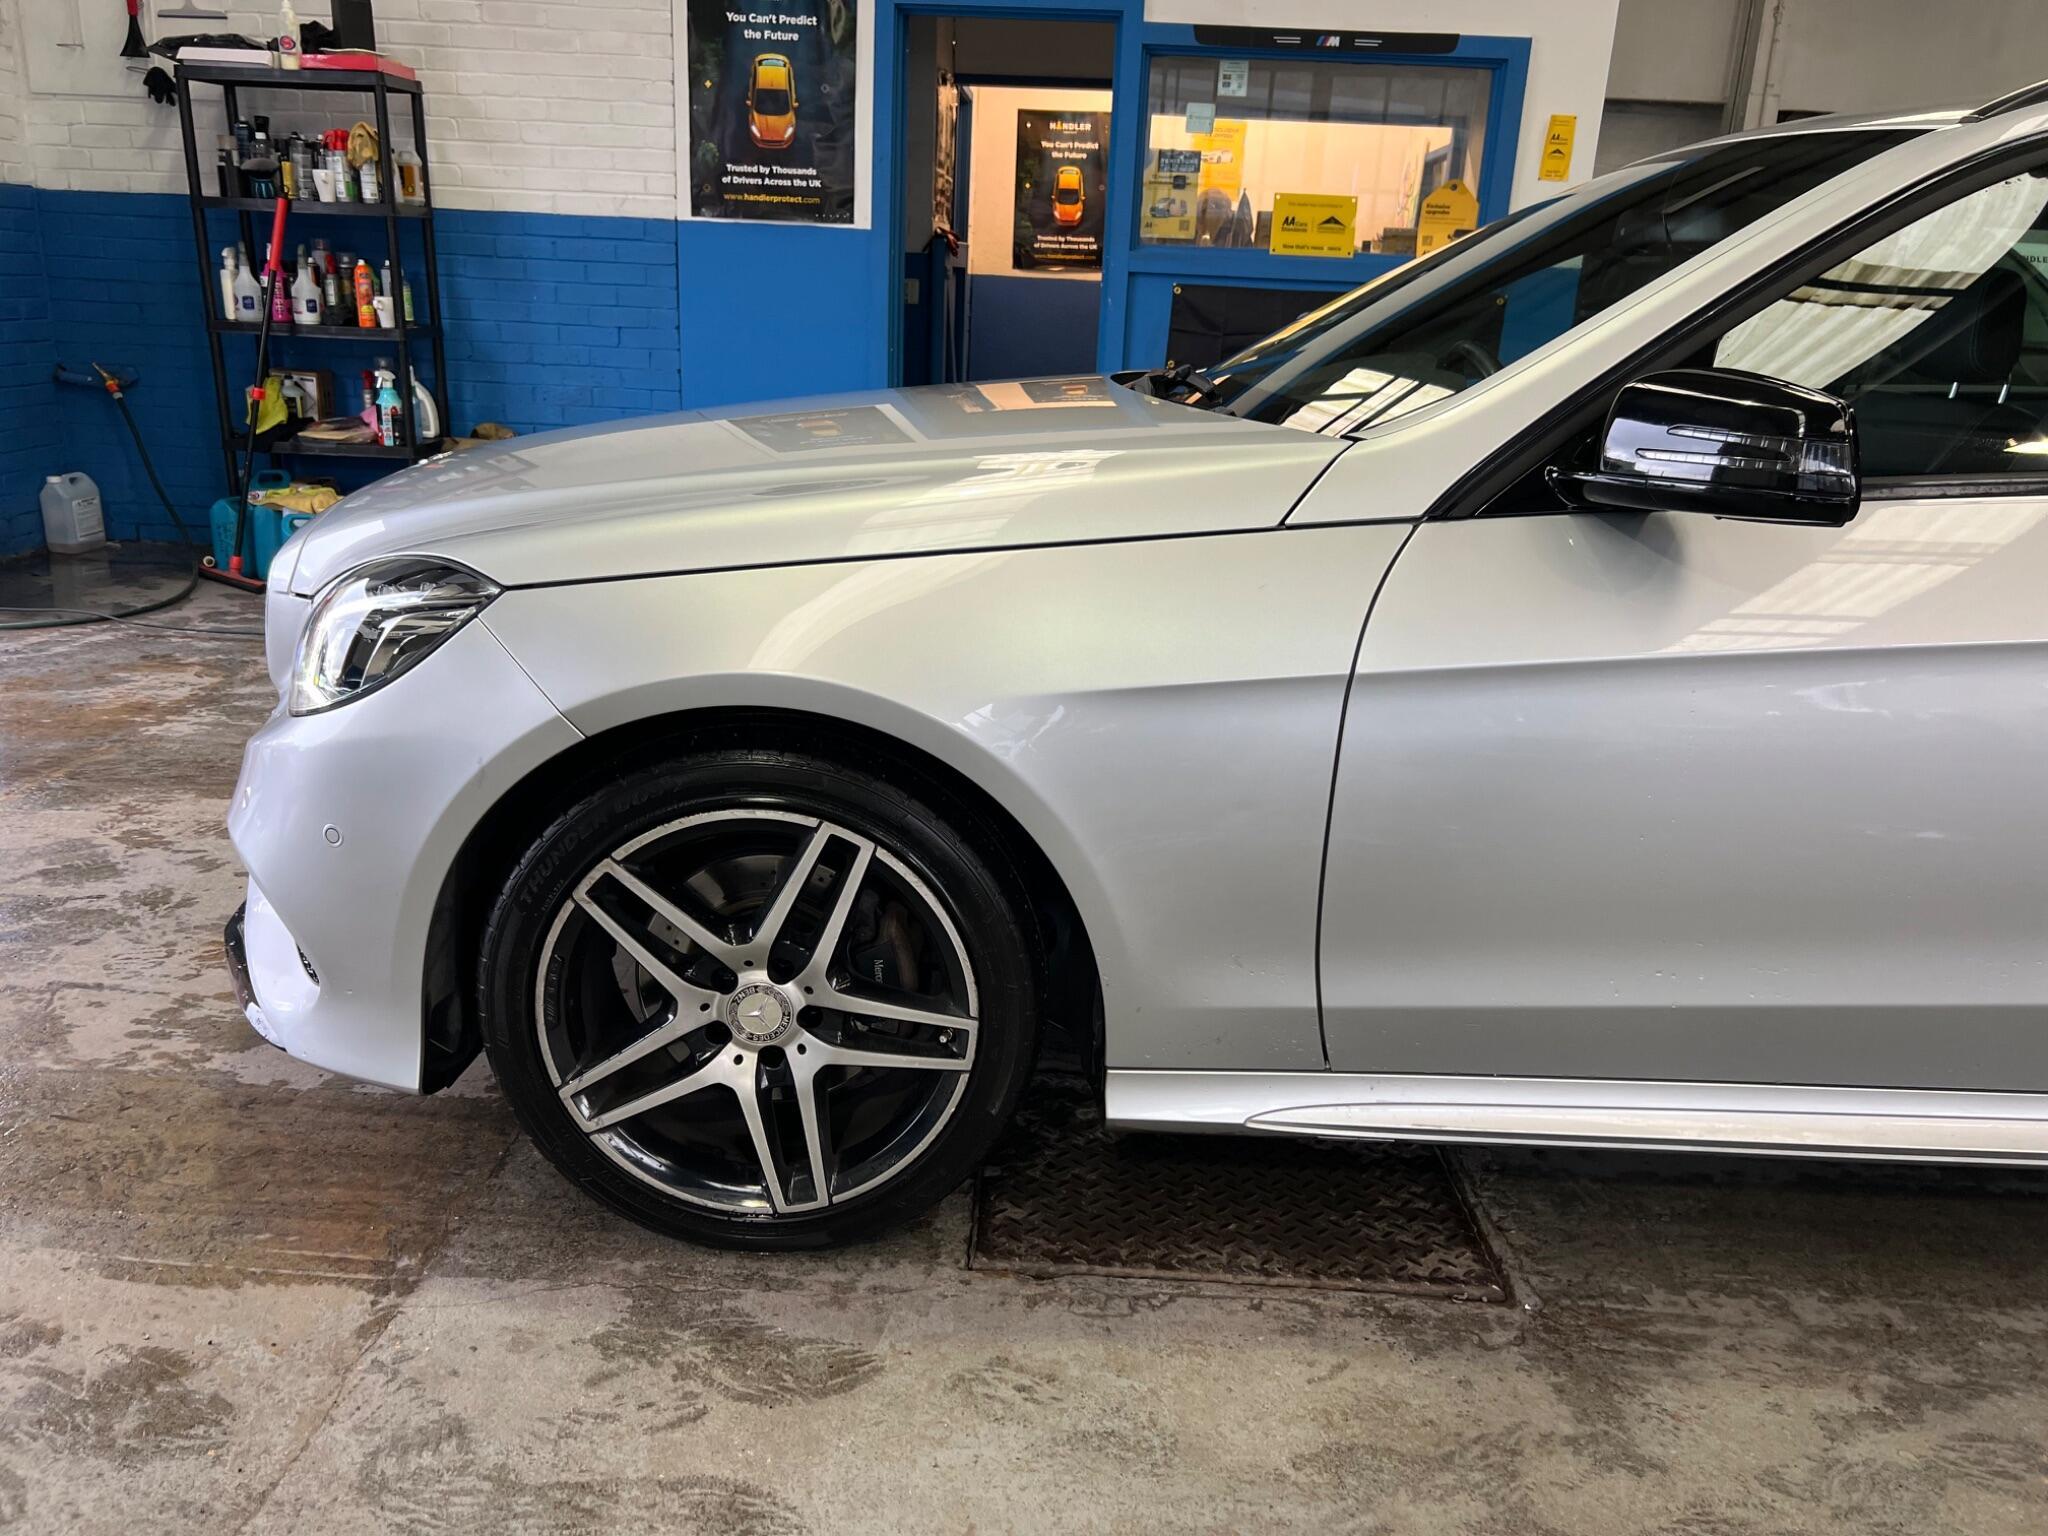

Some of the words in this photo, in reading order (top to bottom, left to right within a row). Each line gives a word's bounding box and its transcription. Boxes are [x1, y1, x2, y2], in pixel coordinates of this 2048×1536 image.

[726, 12, 746, 22] You
[749, 13, 777, 24] Can't
[779, 15, 818, 26] Predict
[744, 29, 762, 40] the
[764, 30, 799, 41] Future
[726, 163, 758, 173] Trusted
[760, 165, 770, 175] by
[772, 166, 817, 176] Thousands
[722, 175, 732, 184] of
[733, 176, 762, 185] Drivers
[764, 177, 792, 186] Across
[793, 178, 807, 187] the
[809, 179, 822, 188] UK
[723, 193, 821, 205] www.handlerprotect.com
[735, 986, 756, 1005] BENZ
[752, 1015, 790, 1041] MERCEDES
